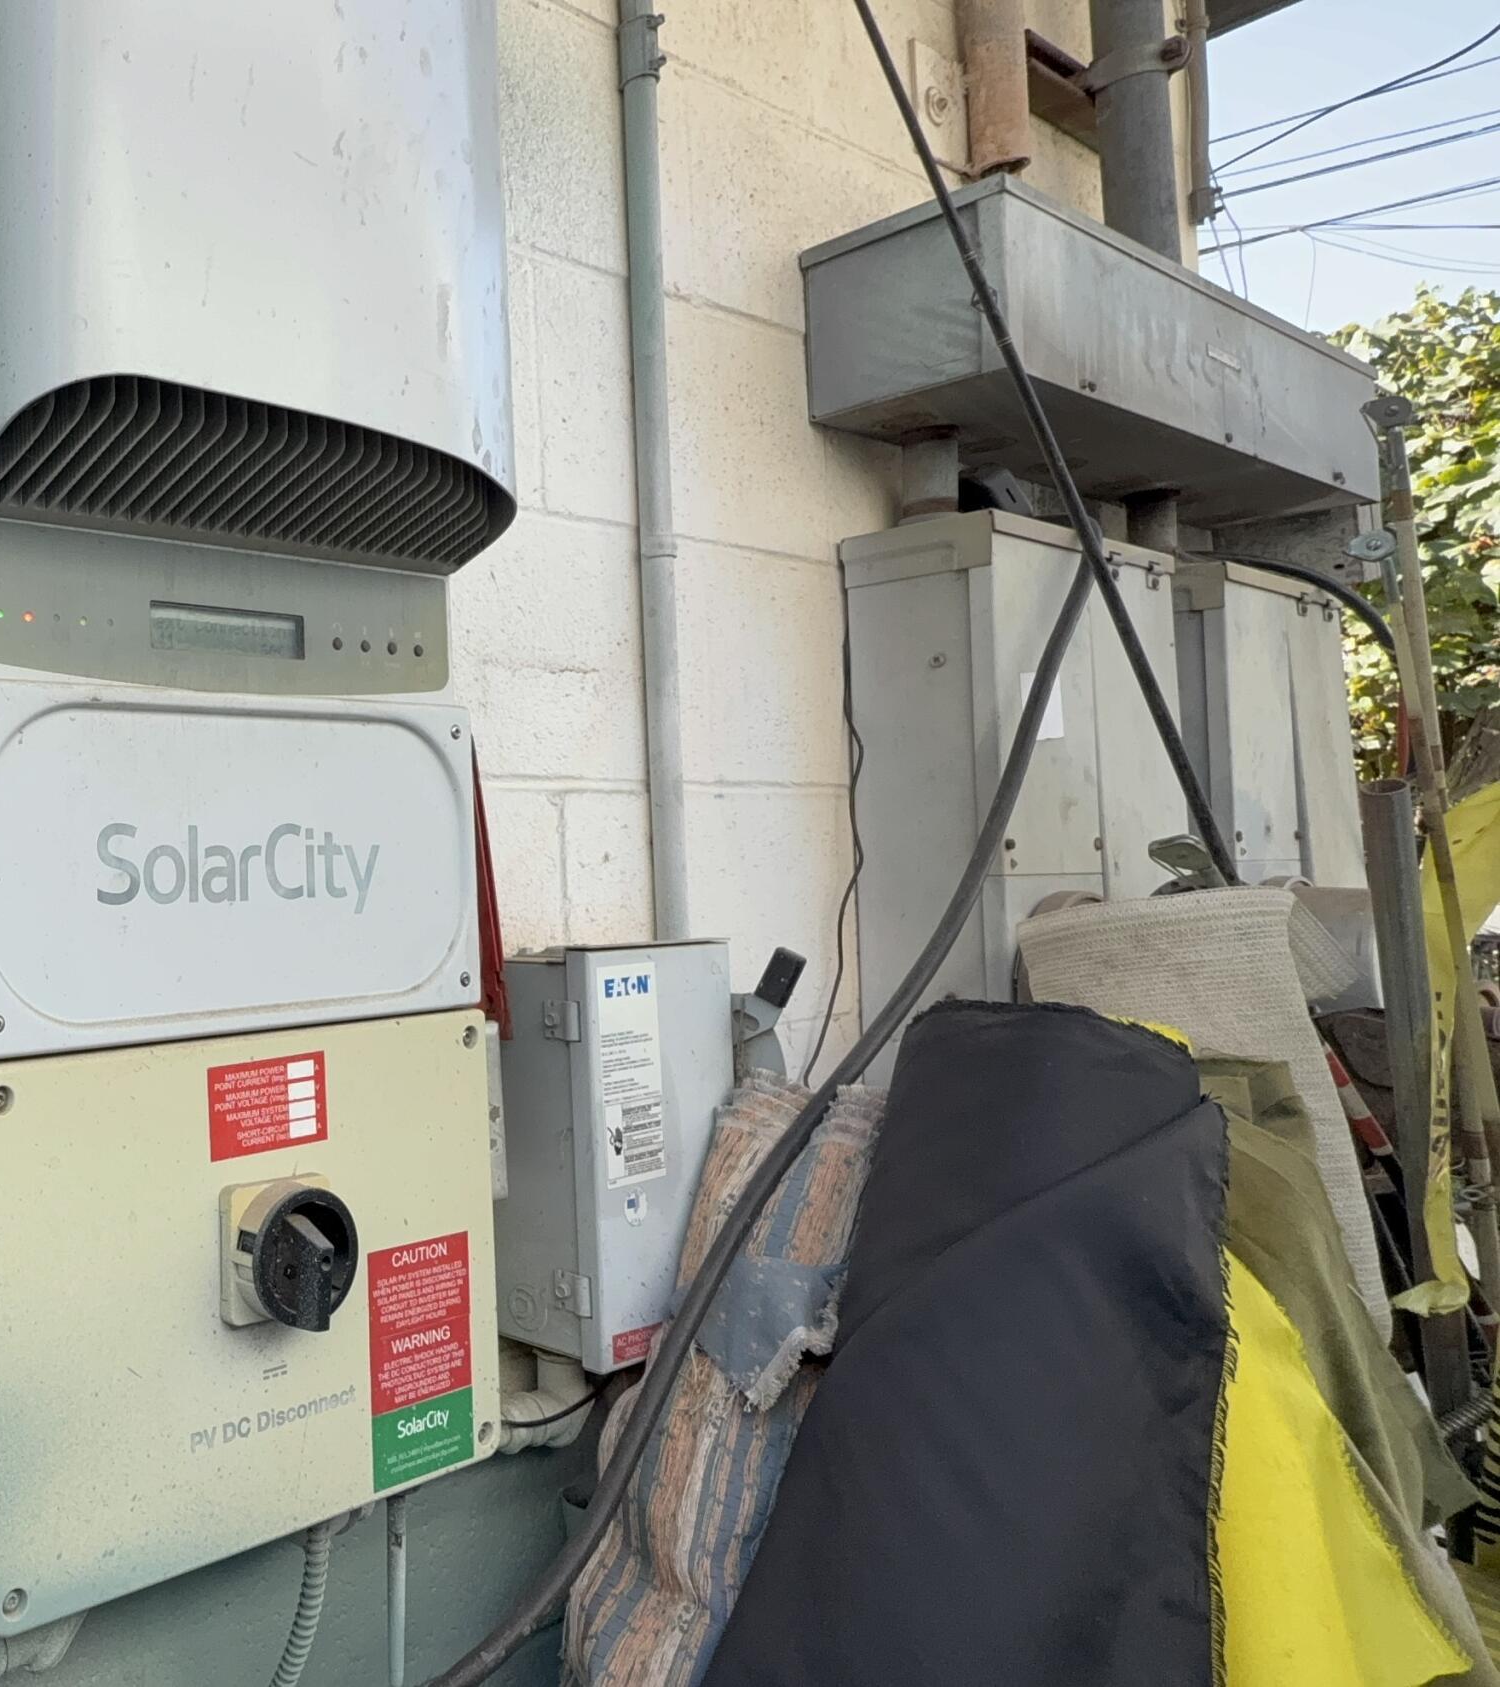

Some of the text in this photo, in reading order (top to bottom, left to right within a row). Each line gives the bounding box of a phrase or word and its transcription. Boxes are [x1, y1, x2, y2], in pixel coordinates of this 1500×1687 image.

[96, 823, 380, 914] SolarCity
[604, 975, 649, 998] EATON
[224, 1065, 285, 1081] MAXIMUM POWER
[214, 1080, 235, 1091] POINT
[237, 1075, 270, 1088] CURRENT
[225, 1085, 286, 1101] MAXIMUM POWER
[214, 1101, 235, 1112] POINT
[236, 1096, 268, 1108] VOLTAGE
[226, 1104, 288, 1122] MAXIMUM SYSTEM
[240, 1116, 271, 1128] VOLTAGE
[236, 1123, 289, 1140] SHORT-CIRCUIT
[242, 1134, 275, 1147] CURRENT
[392, 1241, 448, 1268] CAUTION
[377, 1276, 398, 1288] SOLAR
[391, 1325, 450, 1354] WARNING
[190, 1384, 356, 1454] PV DC Disconnect
[397, 1409, 450, 1439] SolarCity
